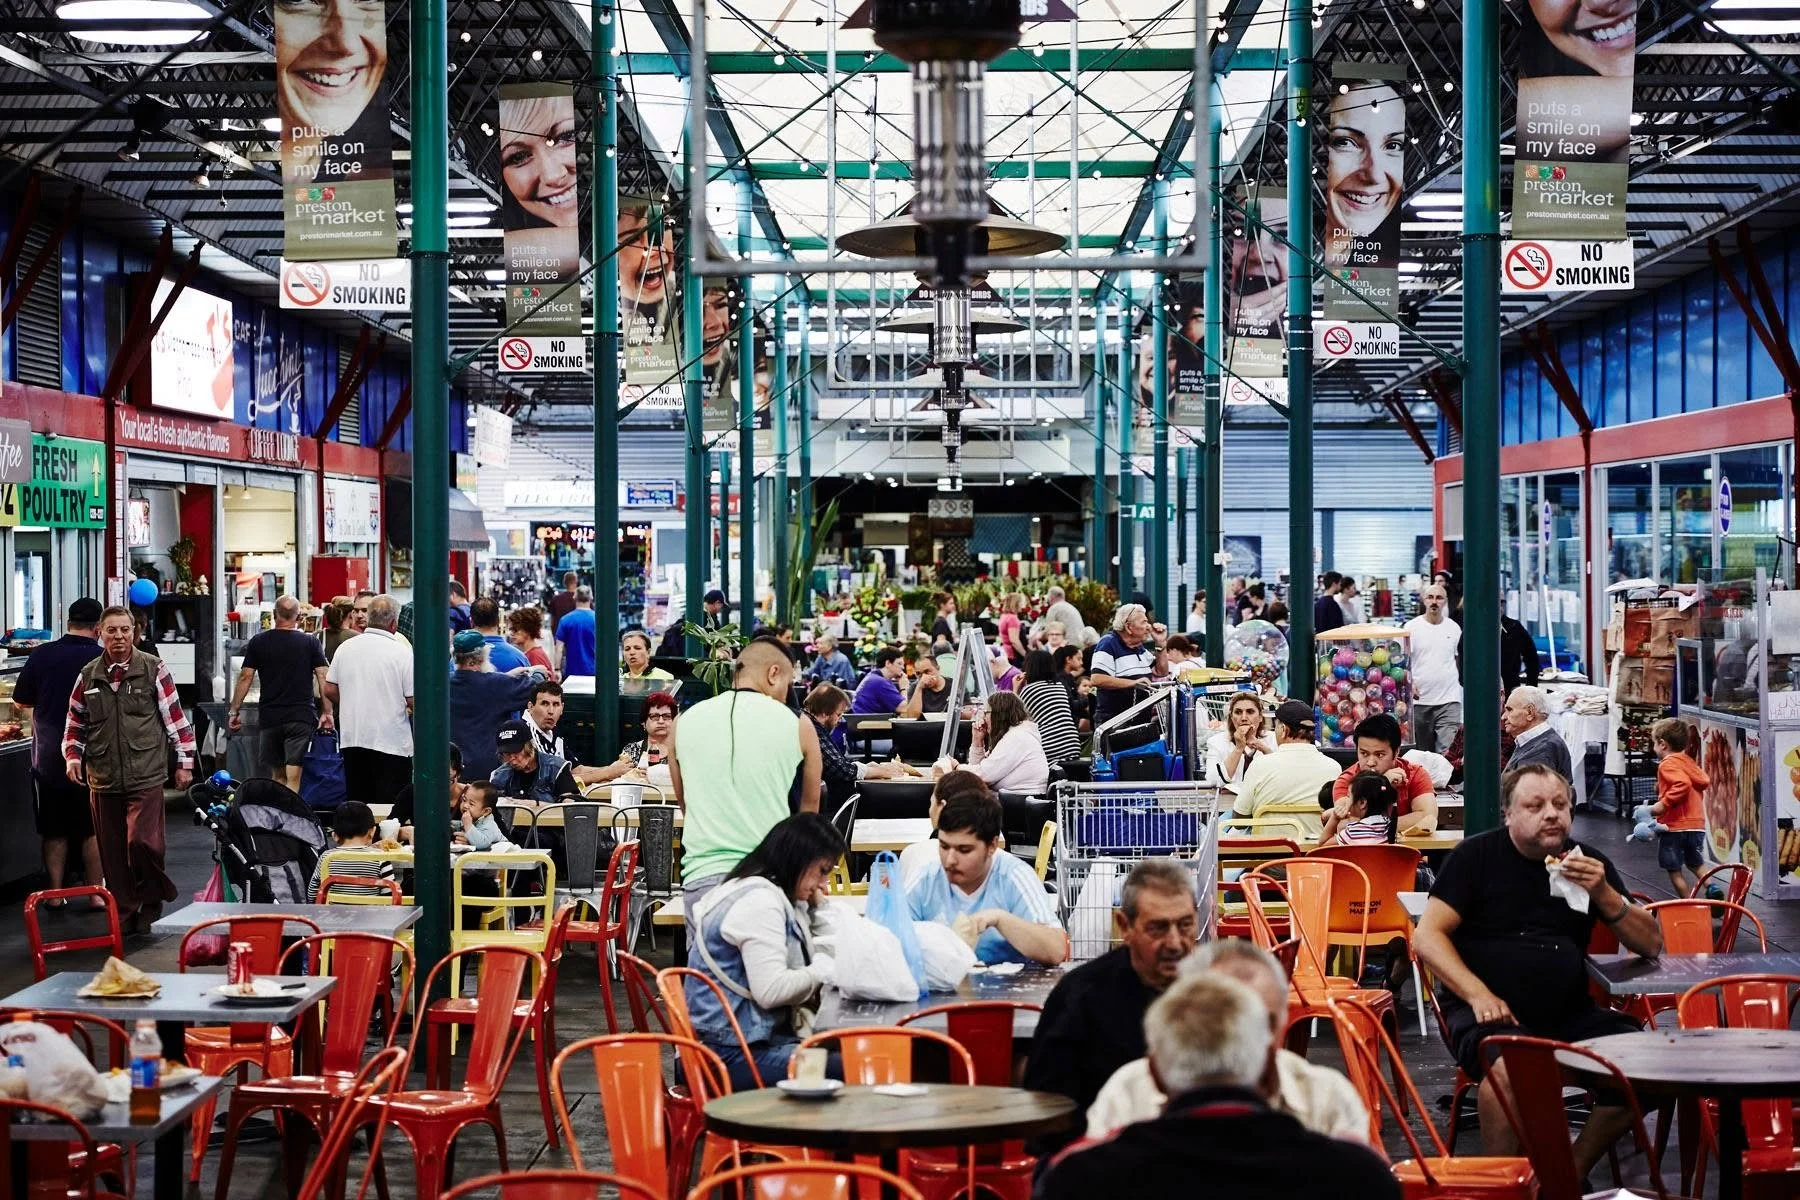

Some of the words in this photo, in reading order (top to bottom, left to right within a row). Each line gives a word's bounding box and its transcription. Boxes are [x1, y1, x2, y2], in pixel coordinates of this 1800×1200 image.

[1528, 102, 1567, 118] puts
[1571, 104, 1582, 116] a
[292, 124, 330, 142] puts
[334, 126, 345, 136] a
[1526, 120, 1574, 135] smile
[1578, 123, 1601, 136] on
[292, 141, 339, 158] smile
[342, 142, 365, 155] on
[1526, 140, 1554, 158] my
[1557, 139, 1596, 155] face
[293, 162, 321, 179] my
[325, 161, 362, 175] face
[1523, 179, 1582, 193] preston
[1539, 190, 1615, 206] market
[295, 200, 352, 217] preston
[312, 208, 386, 226] market
[1526, 211, 1610, 220] prestonmarket.com.au
[299, 230, 383, 241] prestonmarket.com.au
[1333, 227, 1360, 239] puts
[1361, 229, 1369, 237] a
[1332, 239, 1364, 250] smile
[1366, 241, 1381, 250] on
[511, 246, 537, 257] puts
[1332, 252, 1350, 264] my
[1353, 251, 1379, 263] face
[1580, 243, 1603, 261] NO
[511, 258, 543, 268] smile
[545, 258, 561, 267] on
[358, 263, 380, 281] NO
[512, 271, 531, 282] my
[533, 270, 559, 280] face
[1555, 266, 1630, 286] SMOKING
[332, 286, 406, 305] SMOKING
[971, 290, 992, 299] BIRDS
[513, 296, 549, 307] presto
[629, 325, 652, 334] smile
[1249, 326, 1269, 335] face
[1368, 325, 1382, 339] NO
[550, 340, 566, 352] NO
[629, 335, 643, 345] my
[644, 334, 664, 343] face
[1354, 341, 1397, 355] SMOKING
[533, 355, 583, 368] SMOKING
[658, 386, 670, 394] NO
[1265, 380, 1275, 389] NO
[645, 397, 683, 406] SMOKING
[1254, 391, 1286, 401] SKING
[119, 410, 137, 440] Your
[136, 413, 159, 443] local's
[159, 417, 177, 446] fresh
[177, 421, 206, 450] authentic
[206, 426, 230, 454] flavours
[709, 441, 737, 449] OKING
[32, 444, 78, 482] FRESH
[22, 485, 88, 523] POULTRY
[1139, 506, 1172, 519] AT
